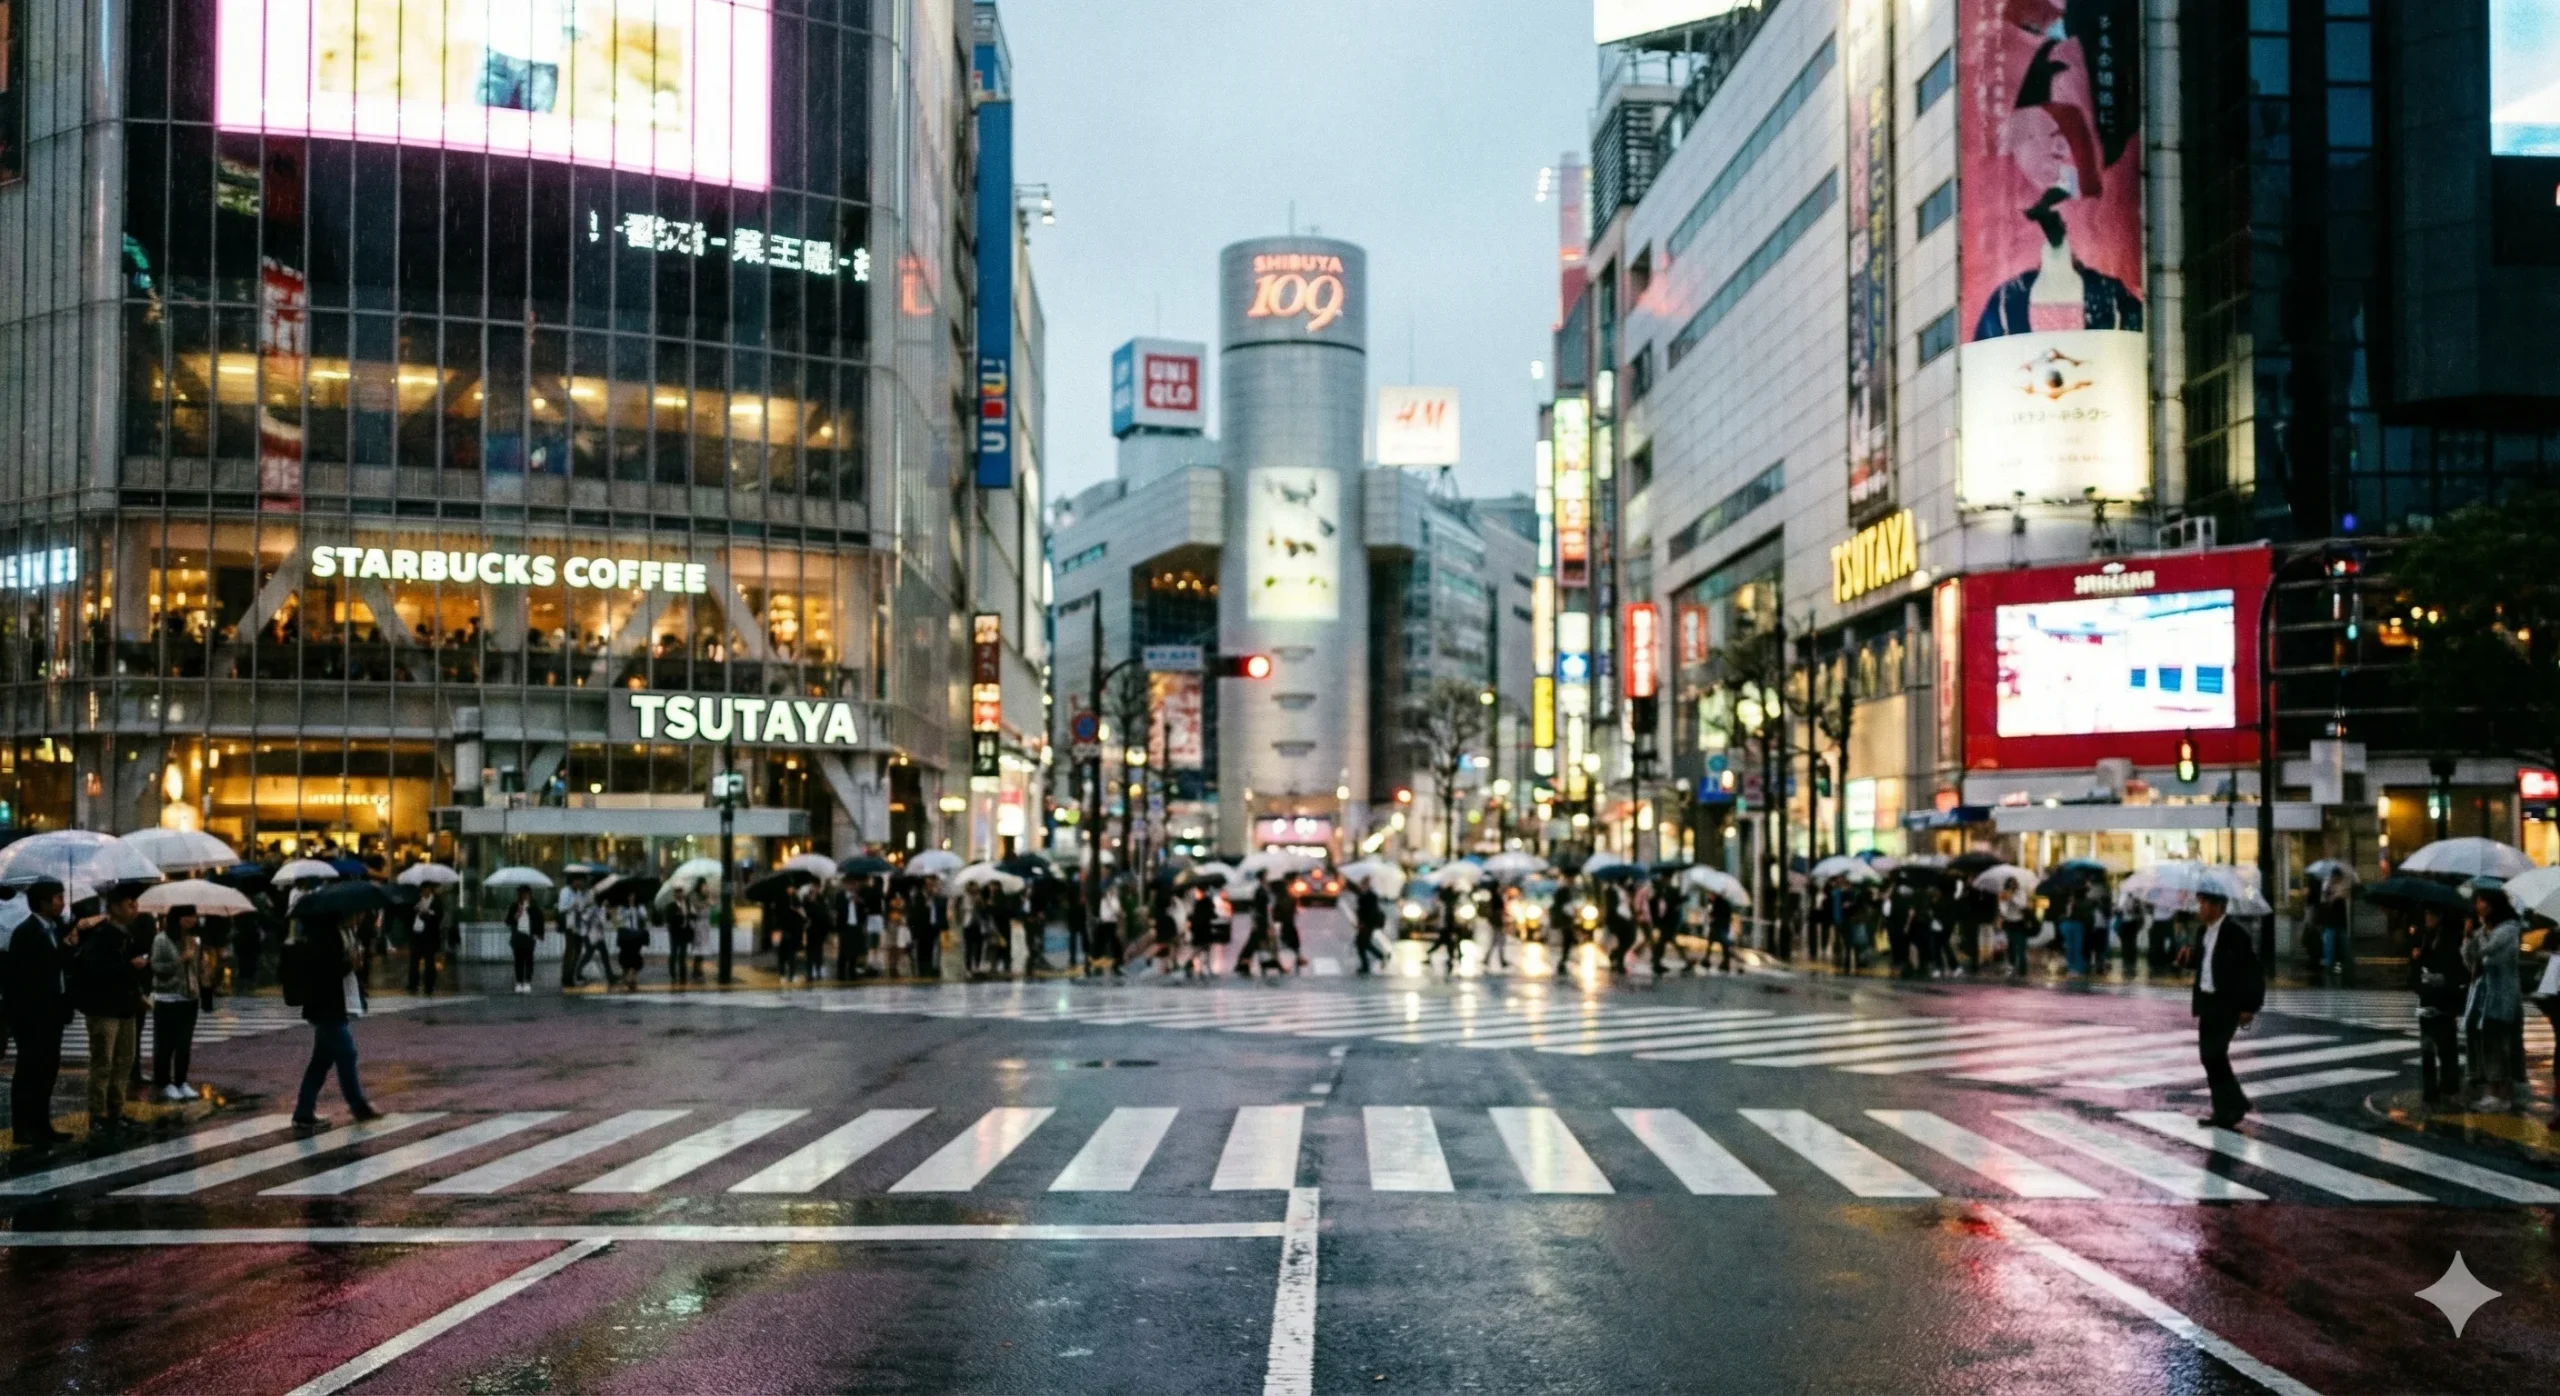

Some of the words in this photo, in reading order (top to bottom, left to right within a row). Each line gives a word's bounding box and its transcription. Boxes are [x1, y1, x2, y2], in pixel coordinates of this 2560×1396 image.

[1253, 253, 1344, 273] SHIBUYA
[1247, 273, 1344, 333] 109
[1149, 361, 1190, 381] UNI
[1149, 383, 1193, 406] QLO
[1391, 398, 1447, 429] HM
[311, 545, 556, 587] STARBUCKS
[563, 556, 708, 594] COFFEE
[1831, 508, 1917, 604] TSUTAYA
[630, 694, 858, 744] TSUTAYA
